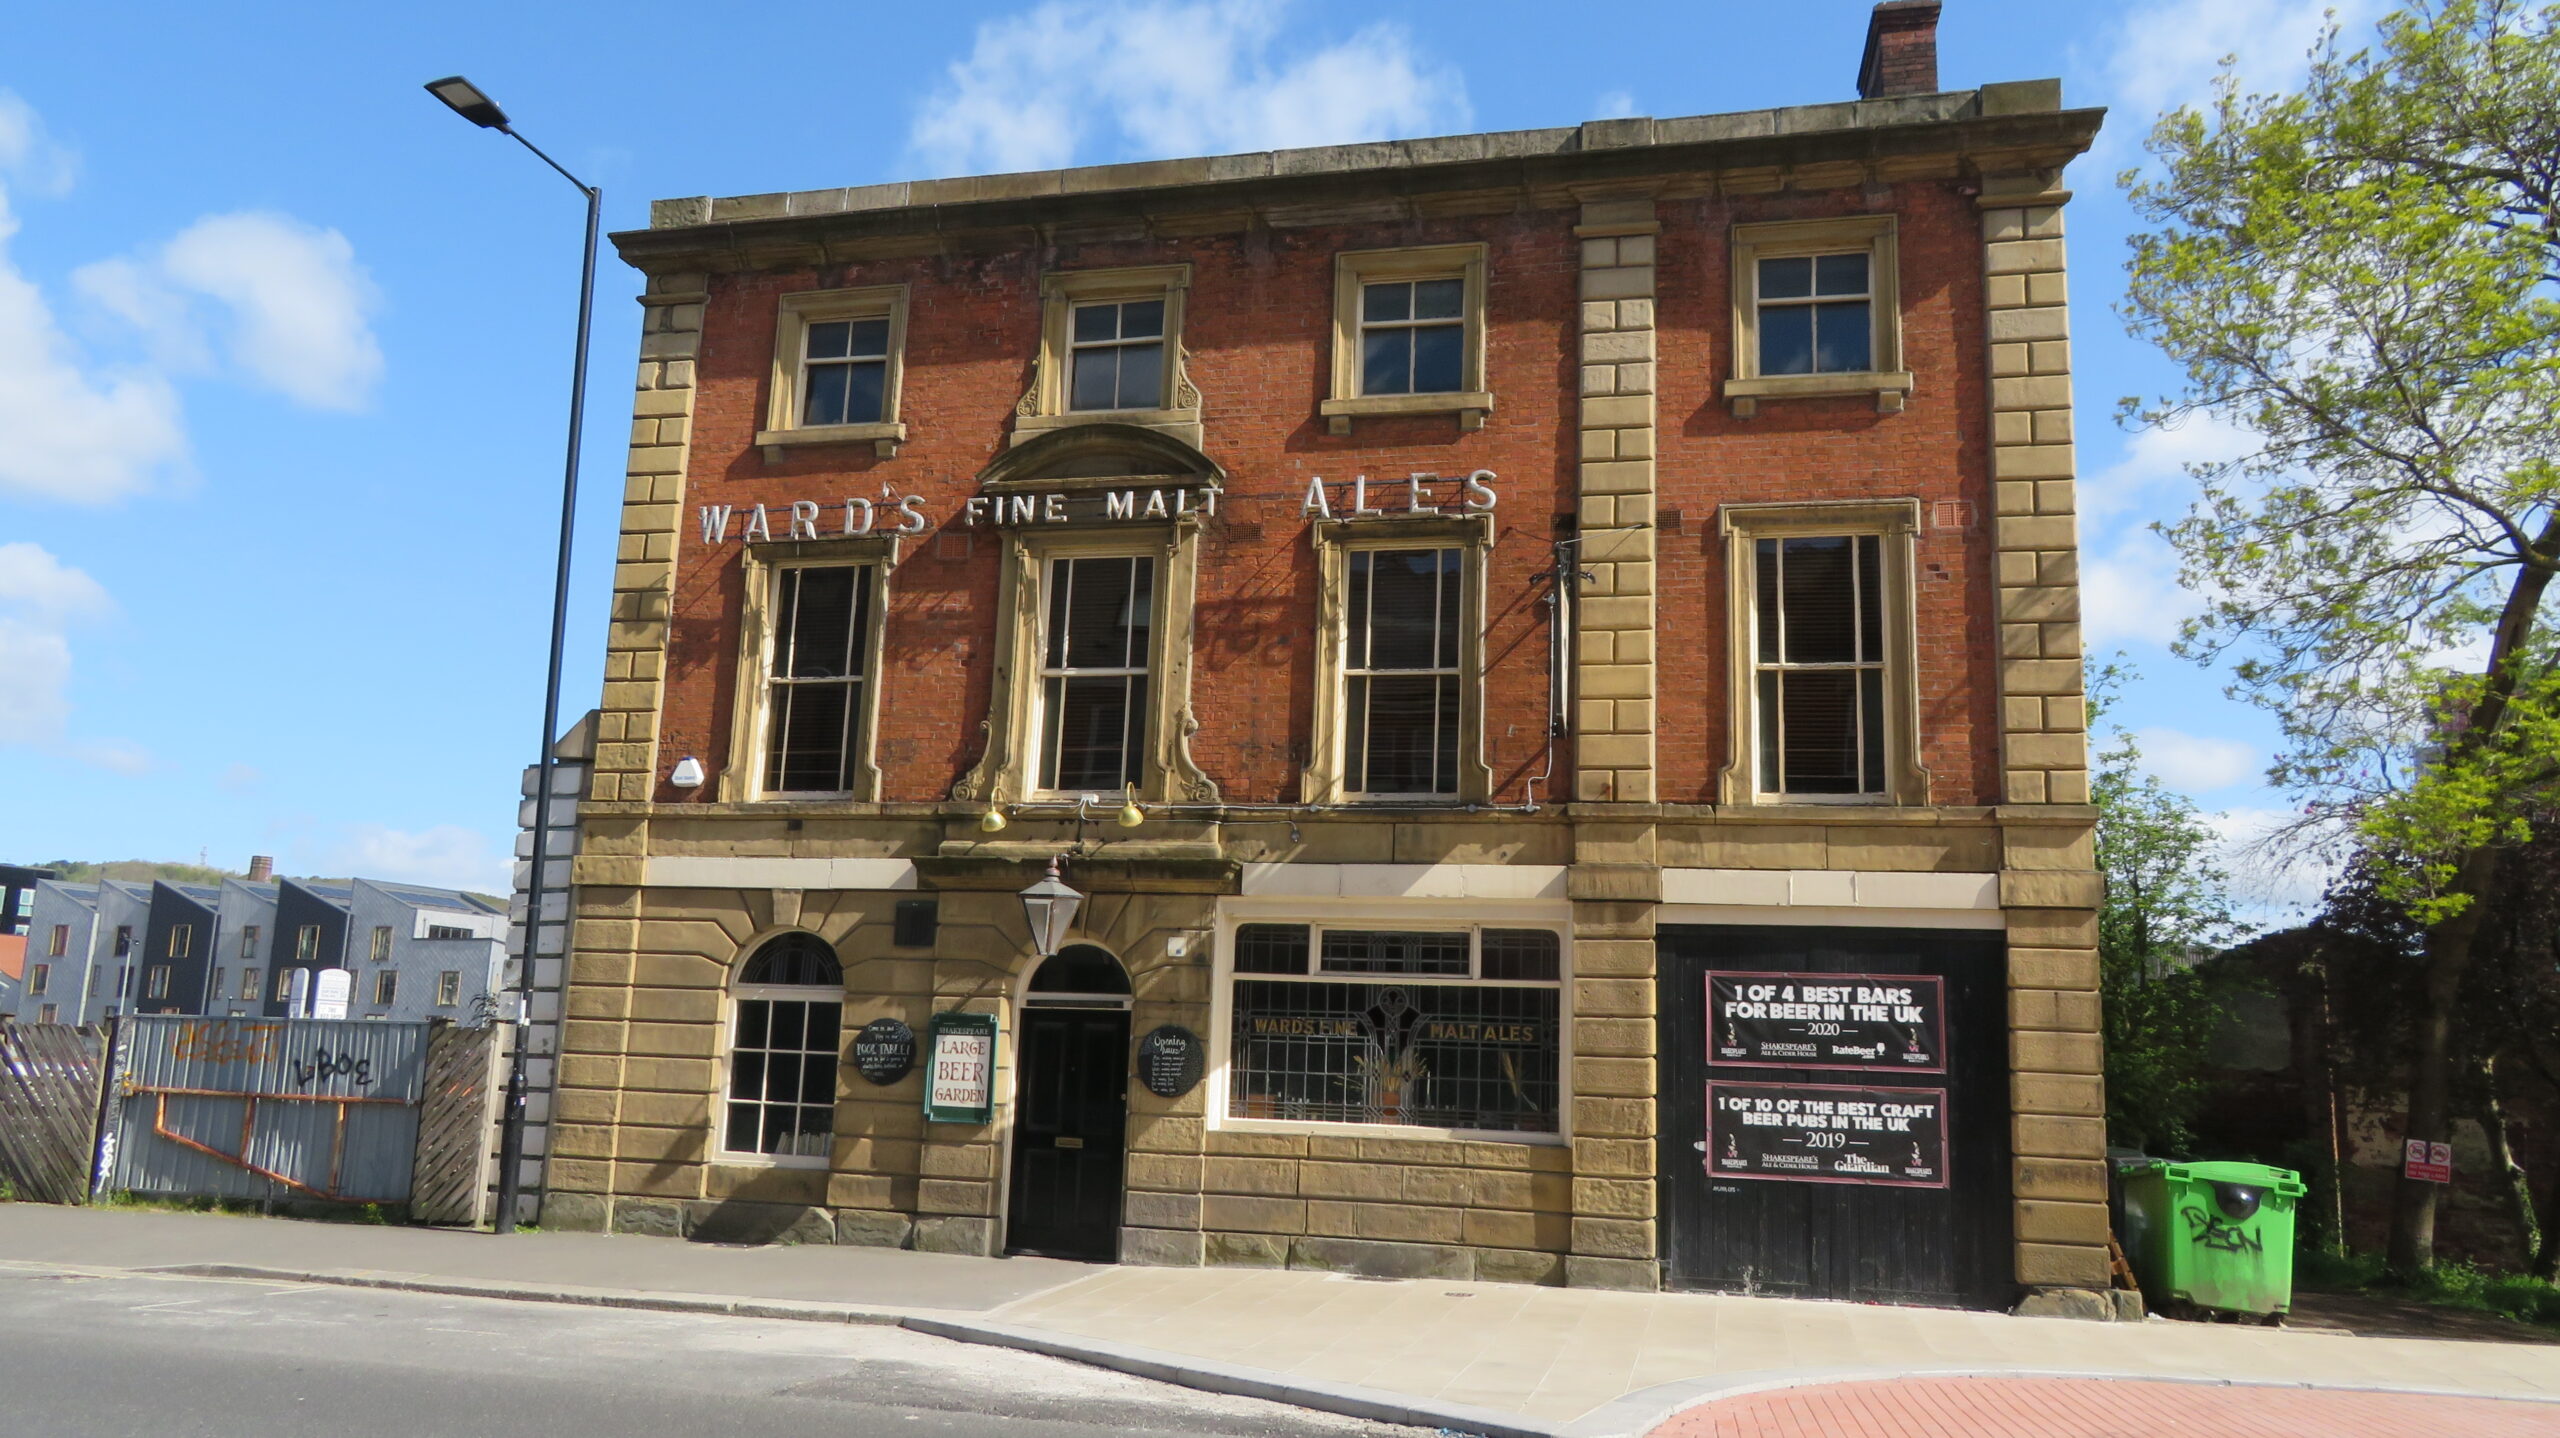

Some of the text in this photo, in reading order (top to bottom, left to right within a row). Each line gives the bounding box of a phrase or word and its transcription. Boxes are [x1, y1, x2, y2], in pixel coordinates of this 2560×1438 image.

[698, 469, 1497, 545] WARD'S FINE MALT ALES
[1734, 984, 1912, 1005] 1 OF 4 BEST BARS
[1725, 1001, 1924, 1023] FOR BEER IN THE UK
[1430, 1023, 1479, 1040] MALT
[1484, 1025, 1534, 1042] ALES
[1807, 1022, 1840, 1036] 2020
[941, 1040, 986, 1057] LARGE
[1154, 1035, 1186, 1052] Opening
[1760, 1041, 1817, 1051] SHAKESPEARE'S
[1832, 1045, 1875, 1055] RateBeer
[938, 1061, 985, 1085] BEER
[935, 1088, 985, 1104] GARDEN
[1719, 1097, 1934, 1118] 1 OF 10 OF THE BEST CRAFT
[1742, 1111, 1910, 1131] BEER PUBS IN THE UK
[1805, 1131, 1846, 1149] 2019
[1761, 1152, 1819, 1163] SHAKESPEARE'S
[1844, 1153, 1867, 1165] The
[1834, 1160, 1889, 1173] Guardian
